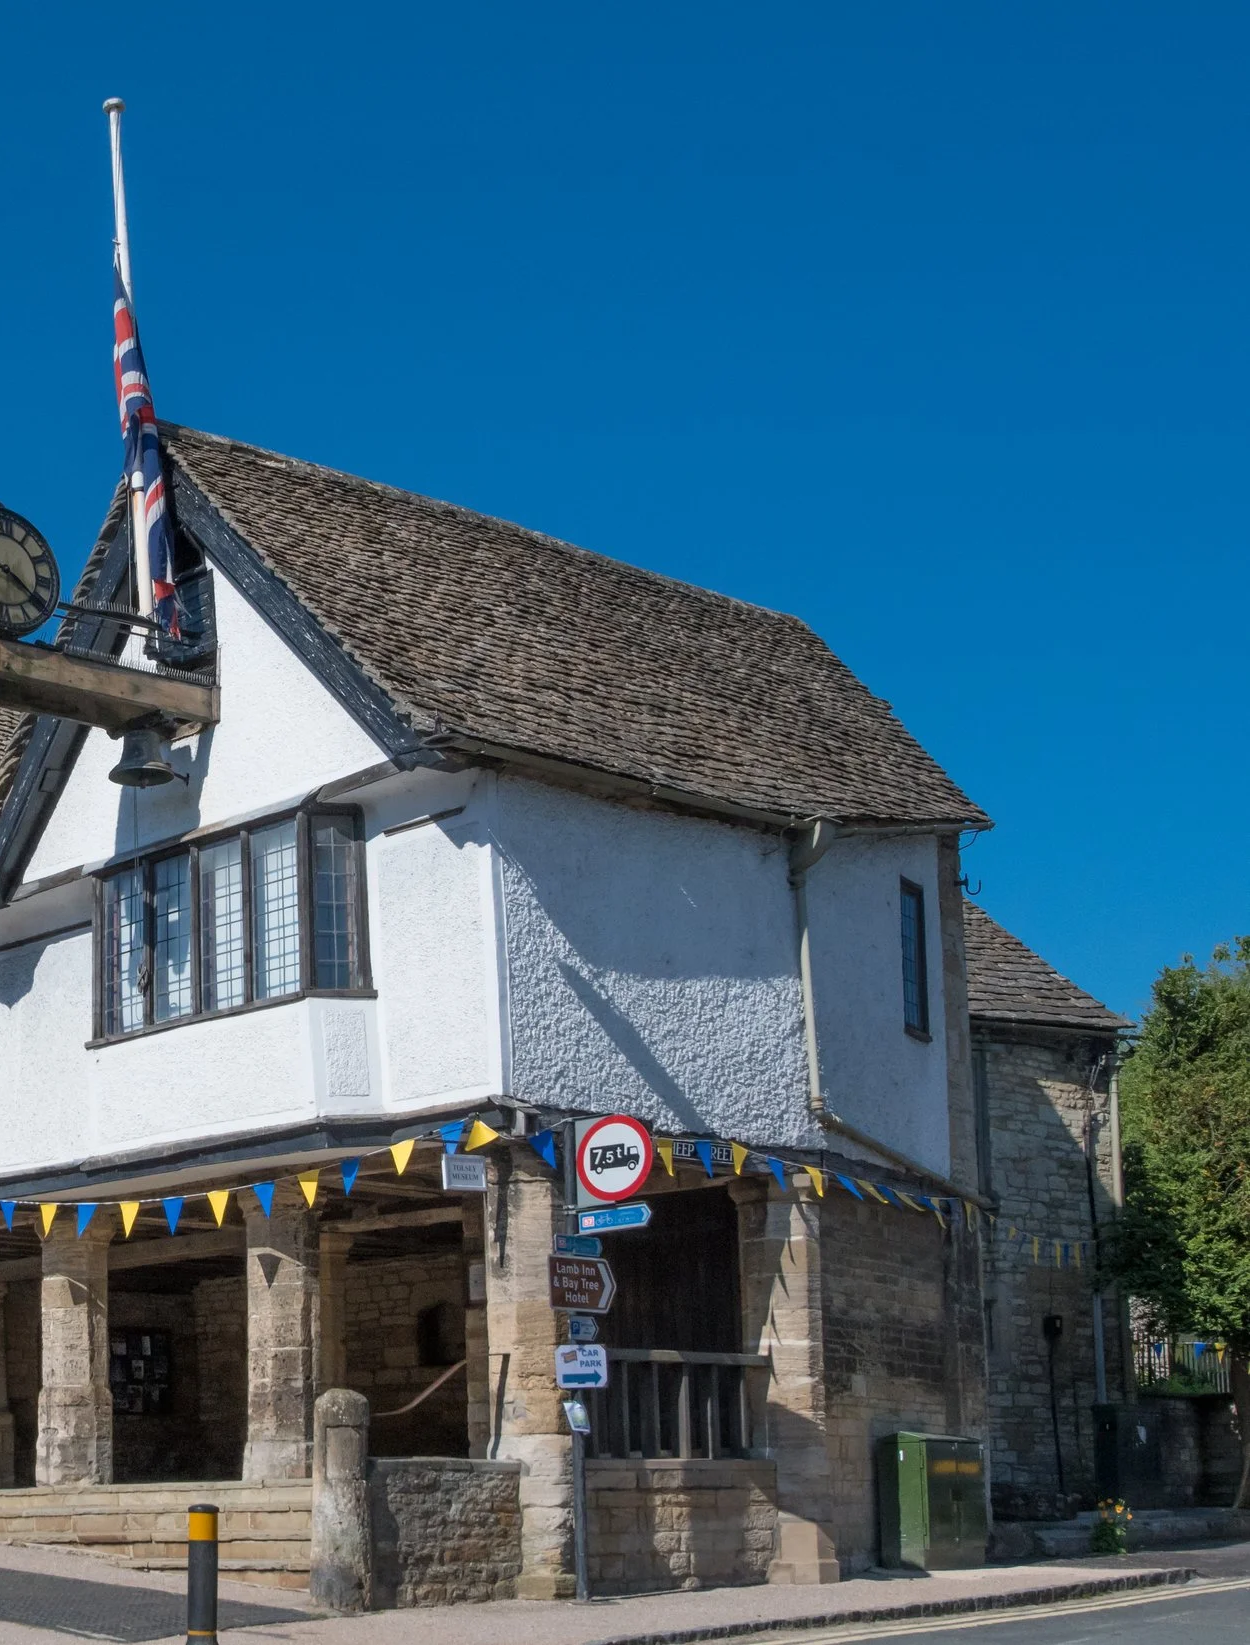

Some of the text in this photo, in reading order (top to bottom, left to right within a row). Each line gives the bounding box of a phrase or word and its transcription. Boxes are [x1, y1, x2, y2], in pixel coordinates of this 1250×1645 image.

[453, 1164, 476, 1172] TOLSEY
[556, 1262, 596, 1276] Lamb Inn
[553, 1276, 599, 1291] & Bay Tree
[565, 1291, 589, 1304] Hotel
[581, 1349, 599, 1357] CAR
[580, 1360, 602, 1368] PARK
